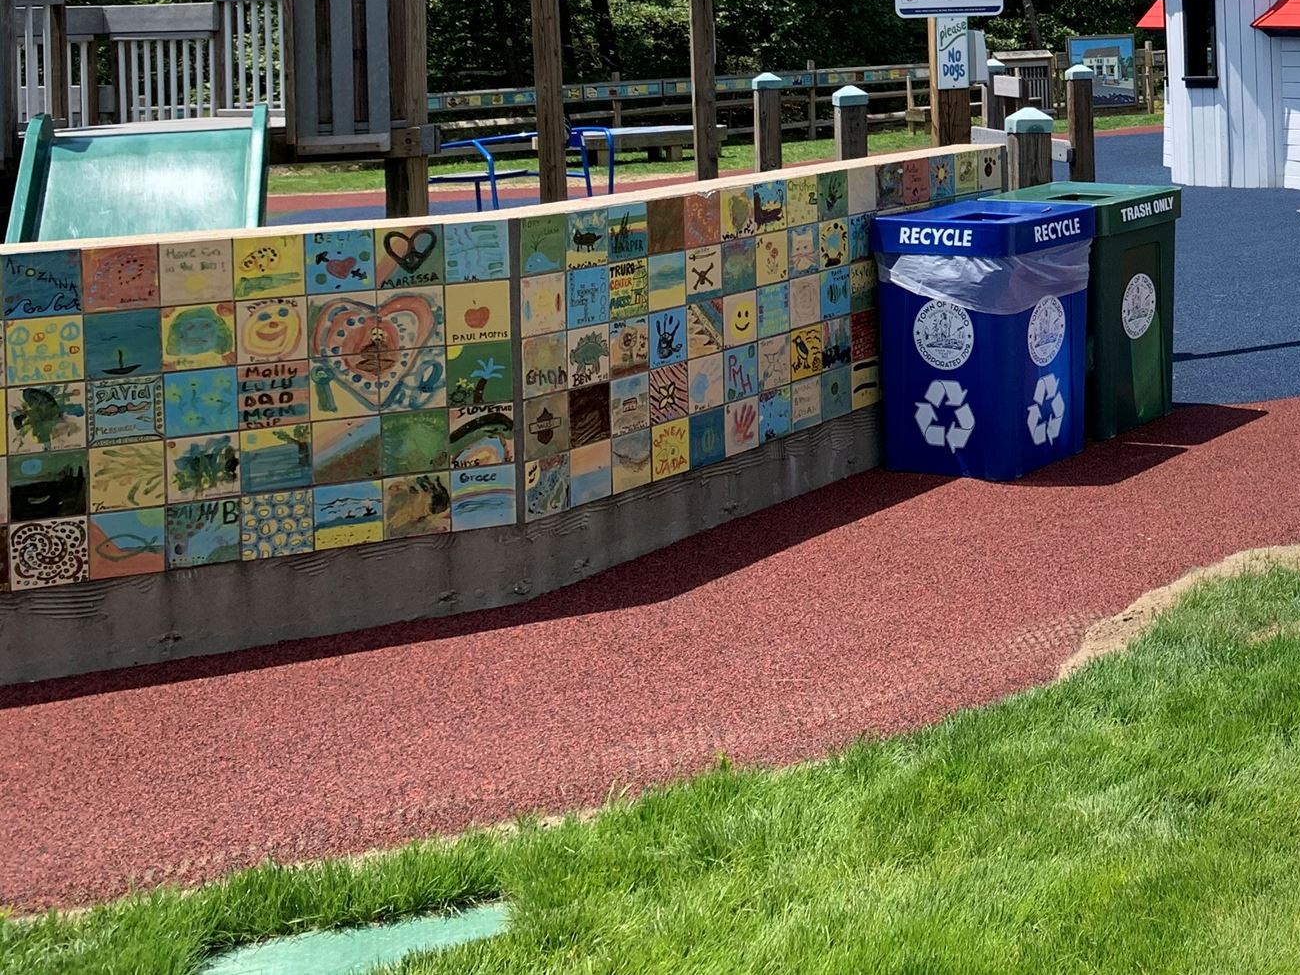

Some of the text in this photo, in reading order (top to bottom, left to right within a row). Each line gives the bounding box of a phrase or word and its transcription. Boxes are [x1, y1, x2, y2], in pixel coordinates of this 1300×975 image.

[940, 21, 967, 47] please
[1120, 196, 1174, 223] TRASH ONLY
[898, 227, 973, 247] RECYCLE
[1034, 218, 1081, 243] RECYCLE
[381, 272, 440, 289] MARISSA
[610, 263, 635, 279] TRURO
[918, 300, 969, 327] TOWN OF TRURO
[452, 333, 476, 343] PAUL
[916, 338, 971, 368] INCORPORATED 1709
[245, 364, 298, 379] Molly
[244, 391, 294, 407] DAD
